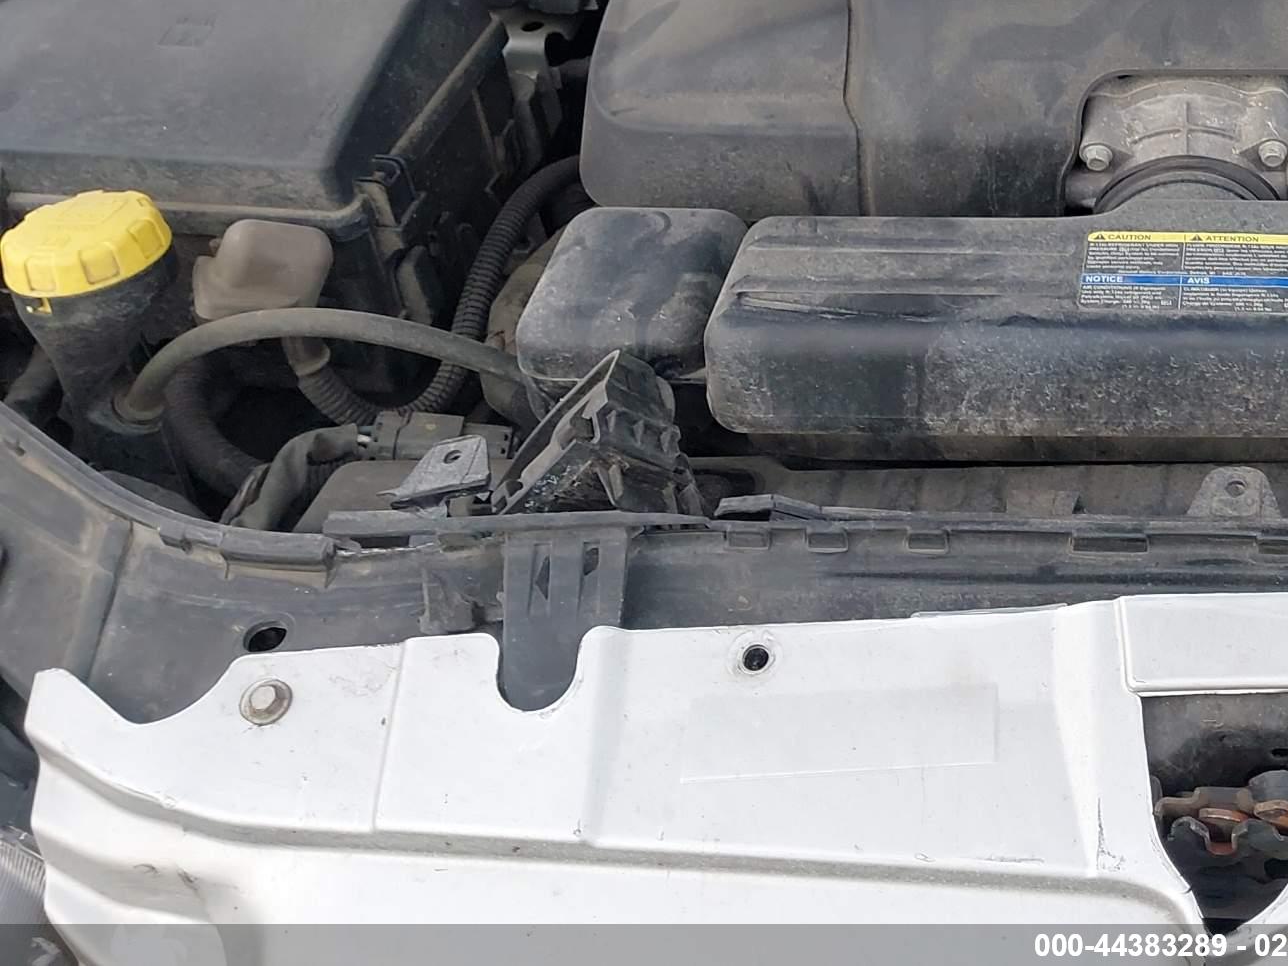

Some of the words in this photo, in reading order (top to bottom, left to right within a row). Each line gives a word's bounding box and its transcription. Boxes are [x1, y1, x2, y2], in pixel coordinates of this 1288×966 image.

[1107, 233, 1152, 241] CAUTION
[1205, 235, 1260, 243] ATTENTION
[1085, 275, 1124, 283] NOTICE
[1186, 277, 1211, 285] AVIS
